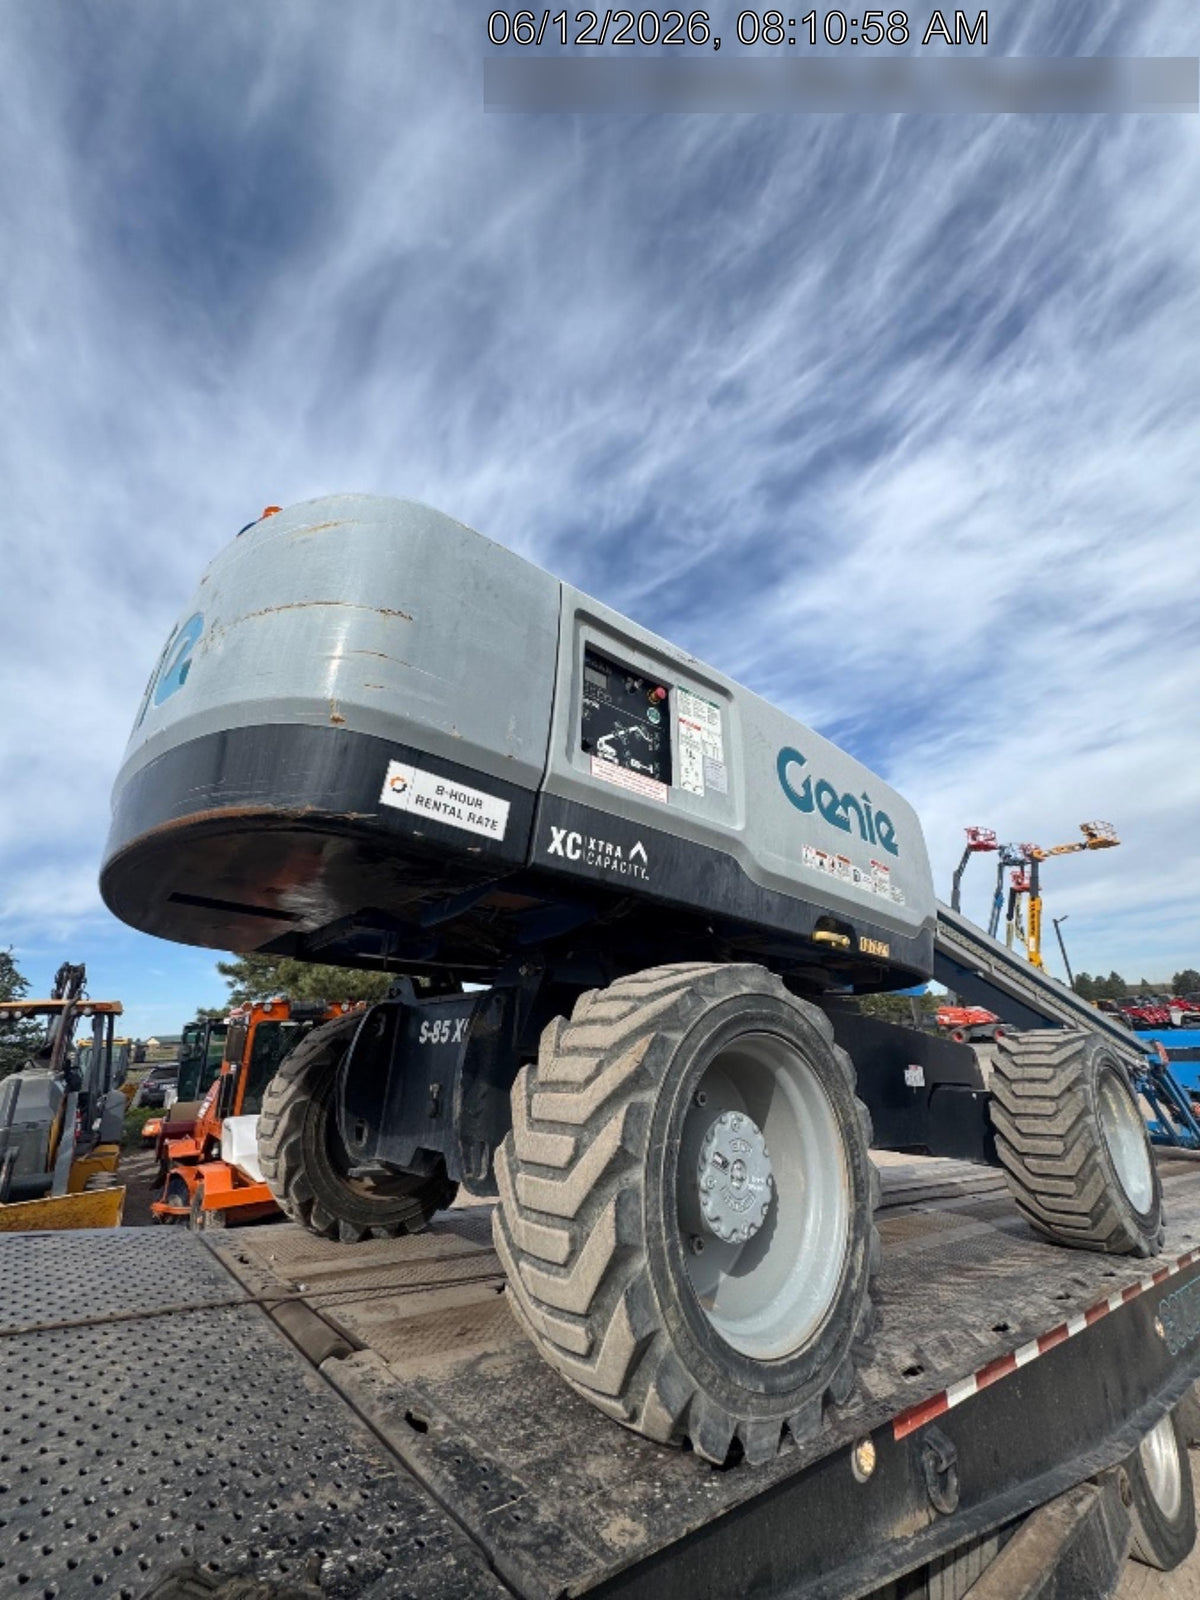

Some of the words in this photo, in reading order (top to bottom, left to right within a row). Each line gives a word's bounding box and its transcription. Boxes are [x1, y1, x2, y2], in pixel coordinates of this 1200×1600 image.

[435, 784, 483, 809] 8-HOUR
[776, 745, 899, 857] Genie
[415, 794, 463, 820] RENTAL
[466, 811, 499, 831] RATE
[547, 825, 582, 860] XC
[588, 836, 623, 859] XTRA
[418, 1019, 452, 1044] S-85
